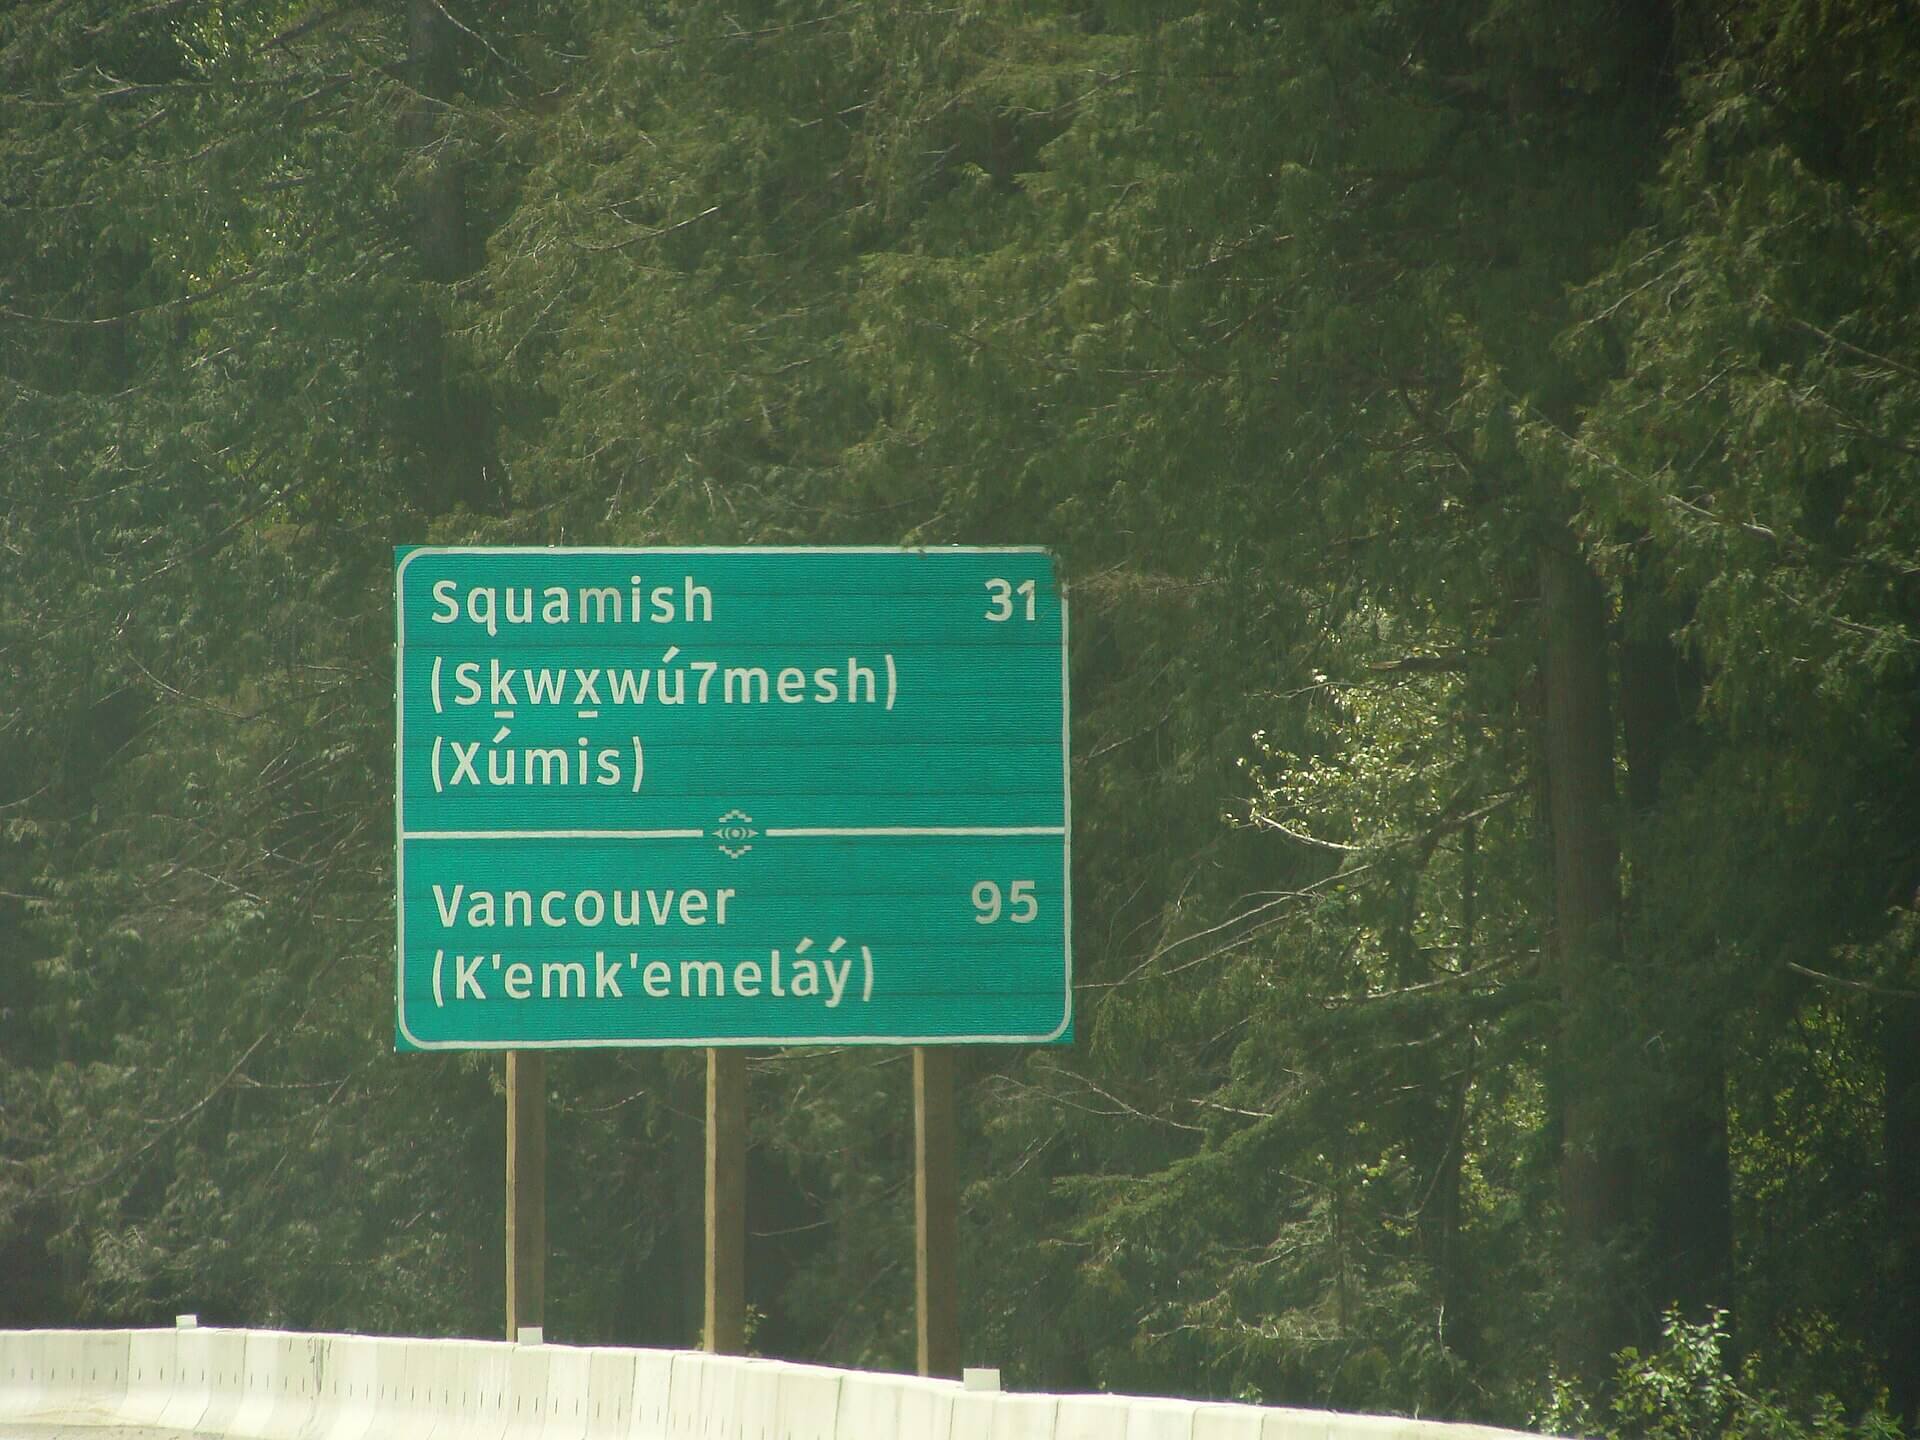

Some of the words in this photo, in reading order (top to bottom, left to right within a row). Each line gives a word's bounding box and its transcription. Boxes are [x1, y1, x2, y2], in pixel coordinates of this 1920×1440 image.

[431, 575, 713, 637] Squamish
[984, 578, 1036, 622] 31
[431, 725, 644, 793] (Xúmis)
[432, 884, 736, 928] Vancouver
[971, 880, 1038, 924] 95
